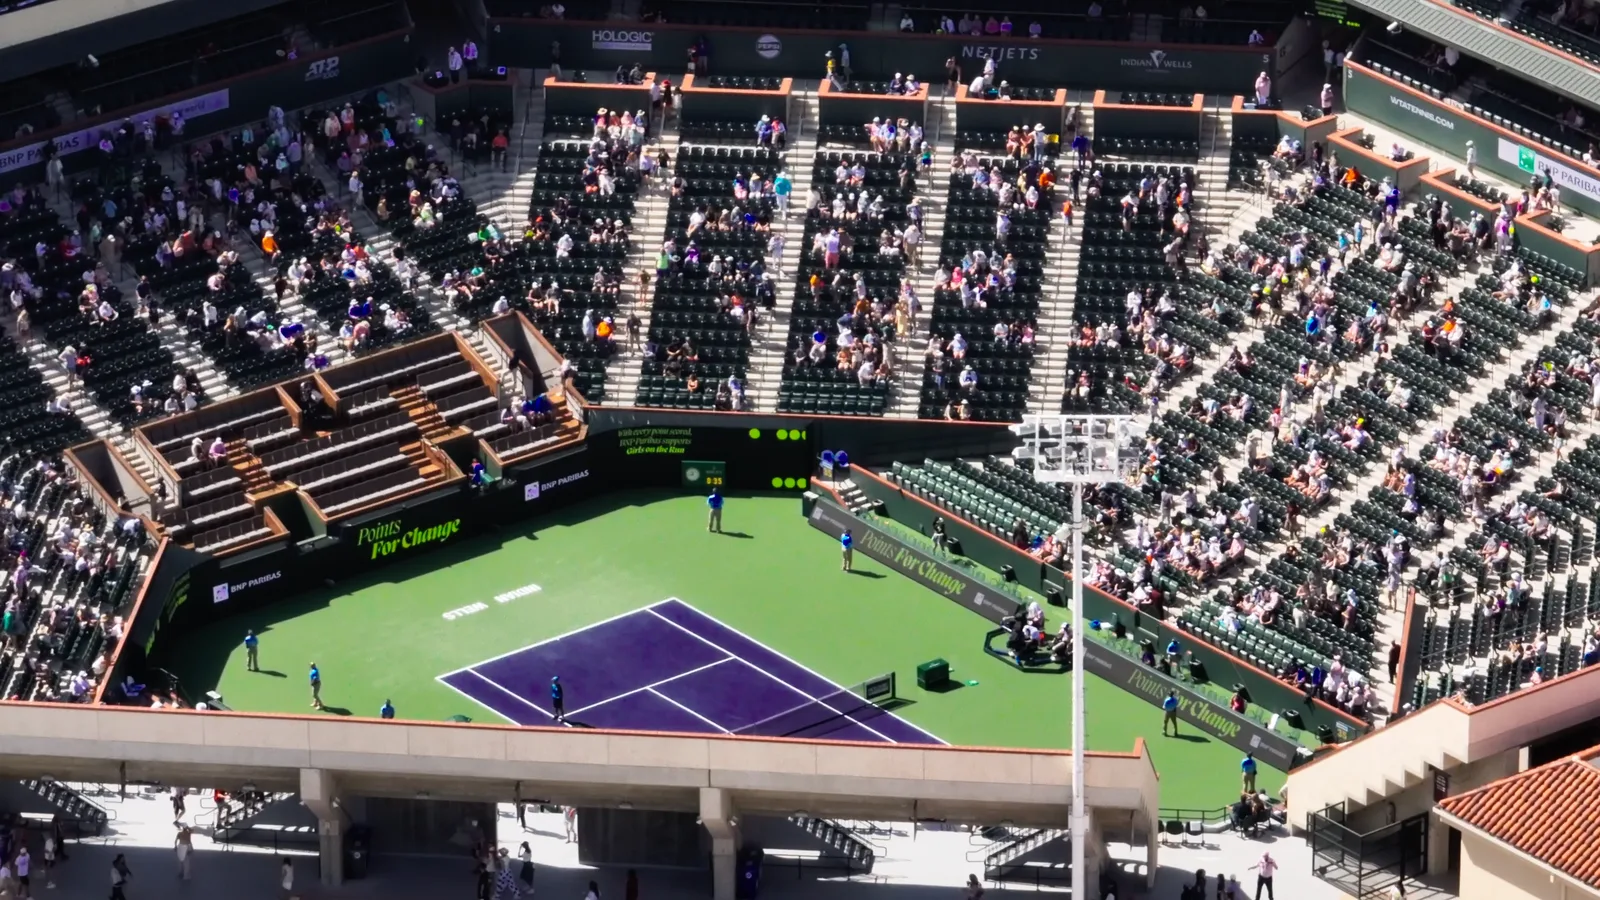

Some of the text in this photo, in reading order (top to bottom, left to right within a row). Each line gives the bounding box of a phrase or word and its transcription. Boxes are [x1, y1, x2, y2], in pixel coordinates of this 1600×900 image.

[592, 30, 653, 43] HOLOGIC
[962, 46, 1039, 62] NETJETS
[1120, 59, 1193, 69] INDIAN WELLS
[1390, 95, 1454, 130] WTATENNIS.COM
[541, 469, 589, 491] BNP PARIBAS
[357, 519, 401, 546] Points
[371, 518, 460, 560] For Change
[860, 530, 967, 595] Points For Change
[230, 571, 282, 593] BNP PARIBAS
[1128, 668, 1167, 700] Points
[1190, 700, 1242, 737] Change
